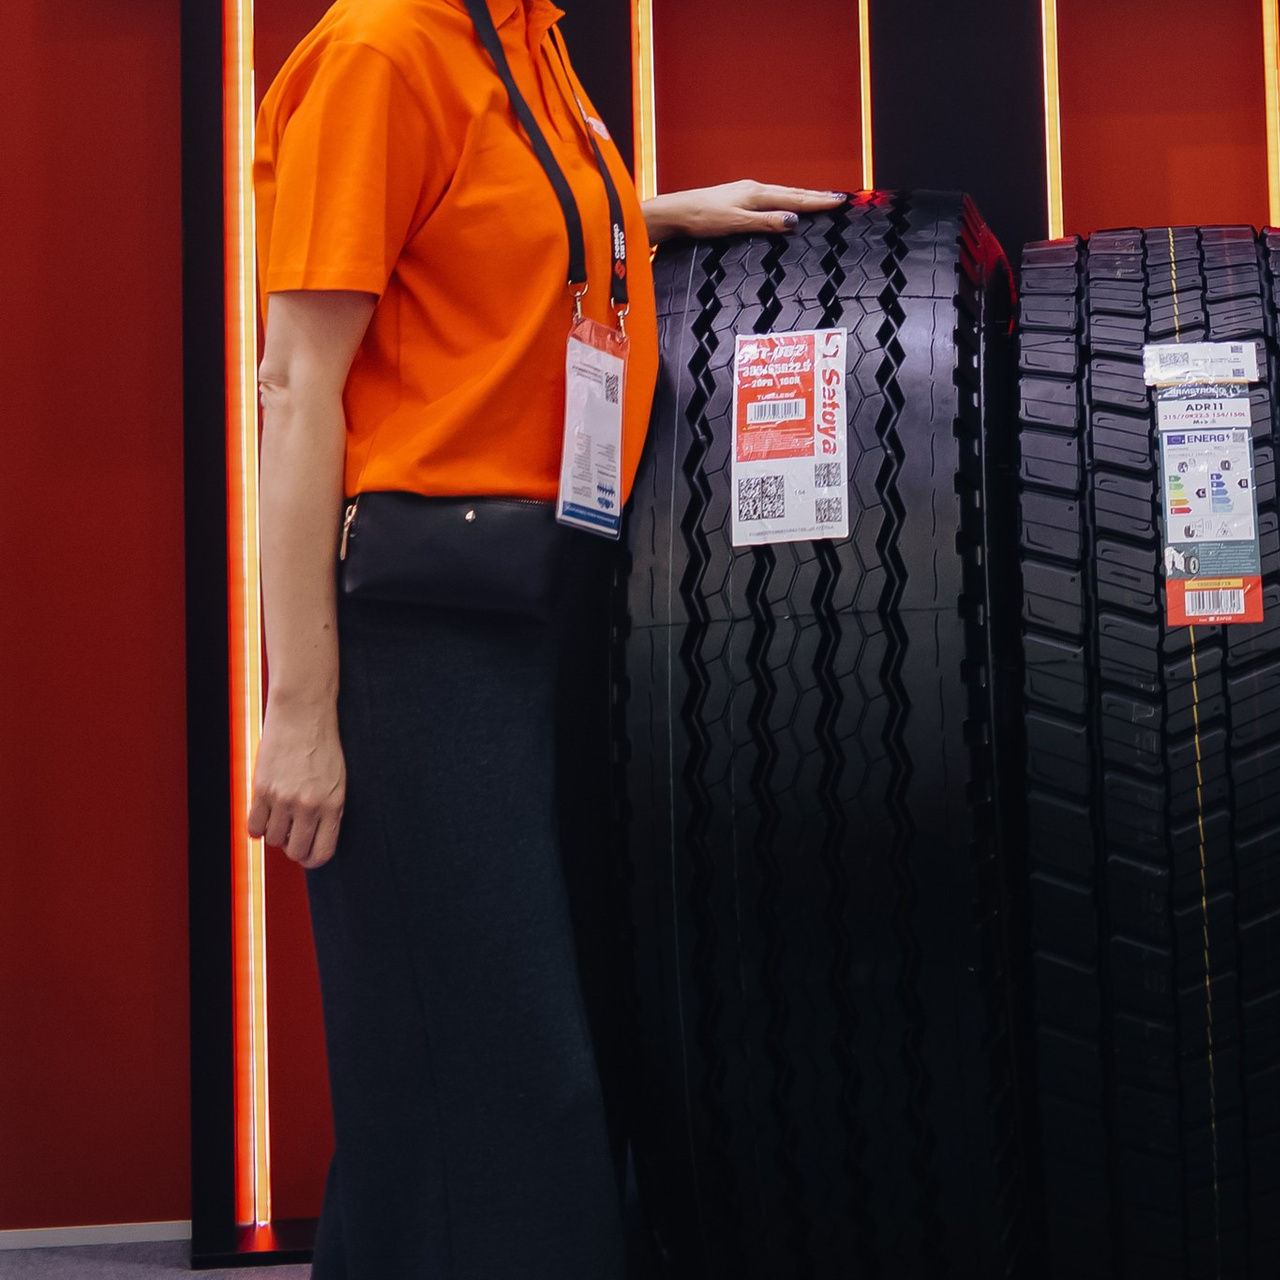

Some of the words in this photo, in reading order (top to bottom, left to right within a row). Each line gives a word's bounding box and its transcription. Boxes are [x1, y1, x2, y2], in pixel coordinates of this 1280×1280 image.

[816, 368, 840, 455] Satoya
[1186, 403, 1223, 412] ADR11
[1187, 434, 1226, 443] ENERG
